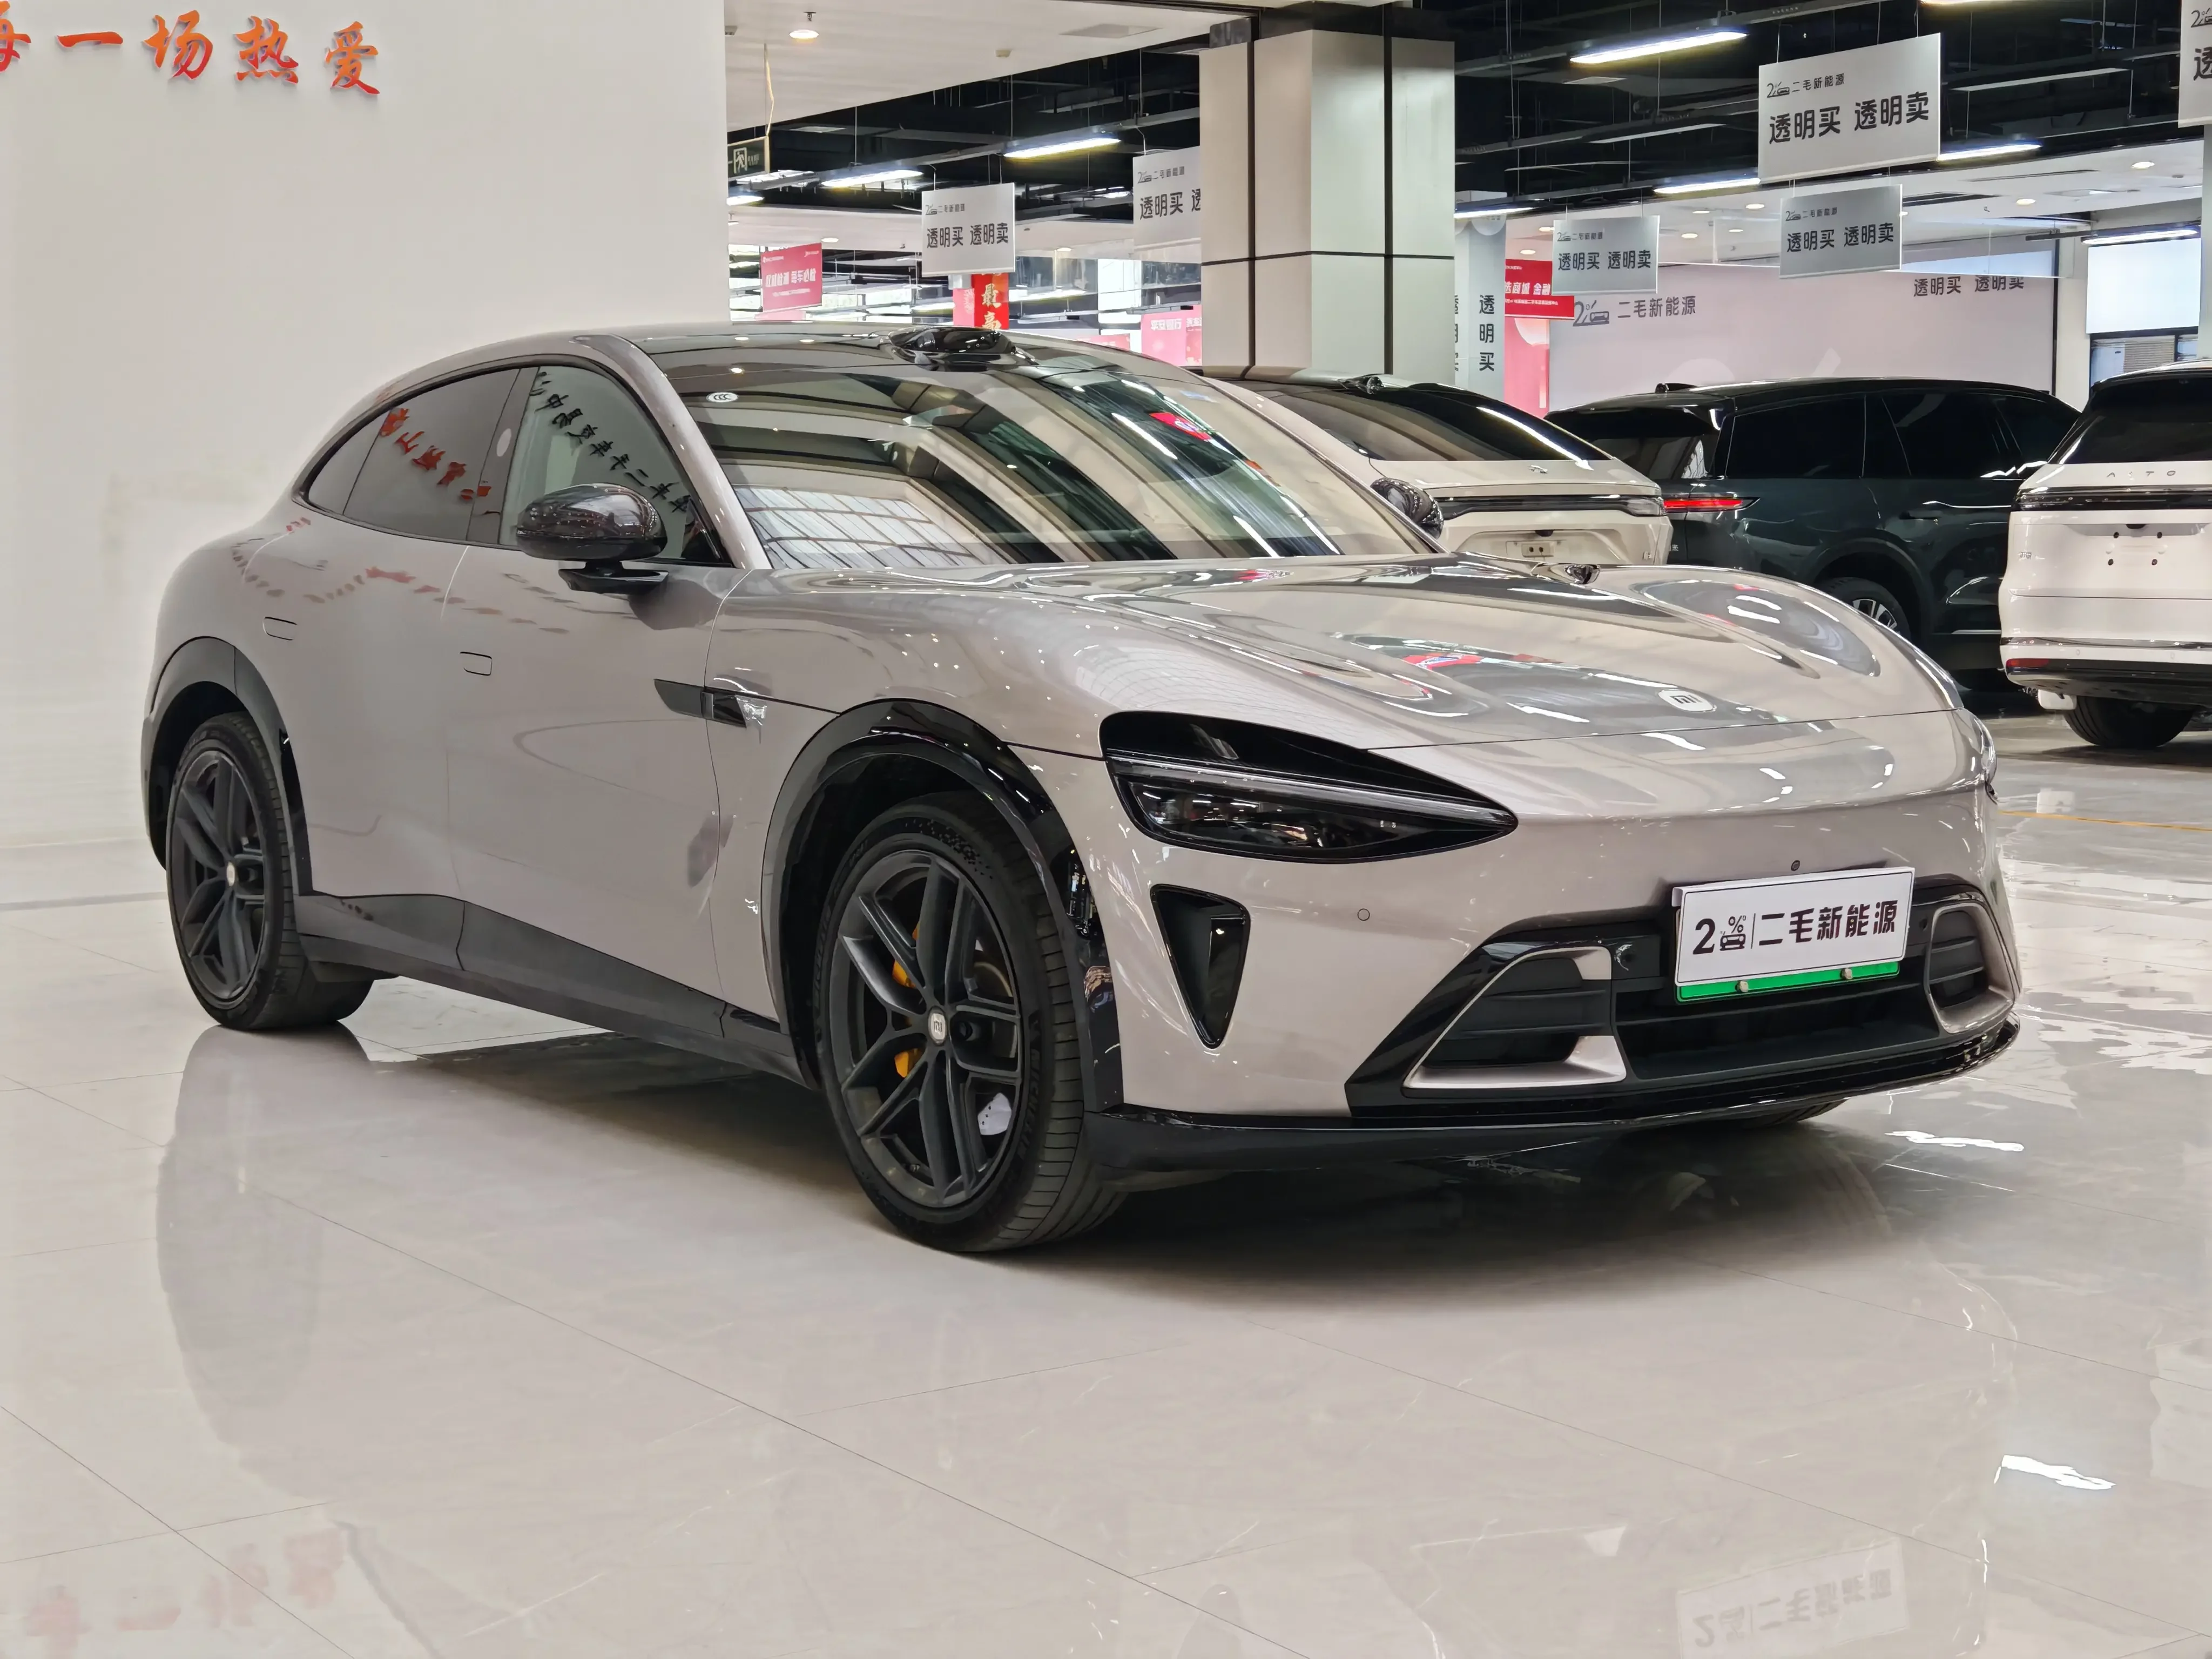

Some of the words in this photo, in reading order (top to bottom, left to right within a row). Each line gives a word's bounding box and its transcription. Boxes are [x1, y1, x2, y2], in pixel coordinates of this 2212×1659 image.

[1792, 73, 1844, 92] 二毛新能源
[1769, 106, 1840, 144] 透明买
[1854, 91, 1928, 131] 透明卖
[1140, 192, 1183, 220] 透明买
[927, 226, 963, 248] 透明买
[970, 222, 1008, 245] 透明卖
[1787, 230, 1835, 252] 透明买
[1844, 222, 1894, 247] 透明卖
[1558, 252, 1600, 271] 透明买
[1608, 249, 1651, 269] 透明卖
[1914, 276, 1961, 296] 透明买
[1618, 296, 1696, 318] 二毛新能源
[1479, 295, 1495, 372] 透明买
[2107, 470, 2176, 480] ATO
[1759, 900, 1898, 946] 二毛新能源
